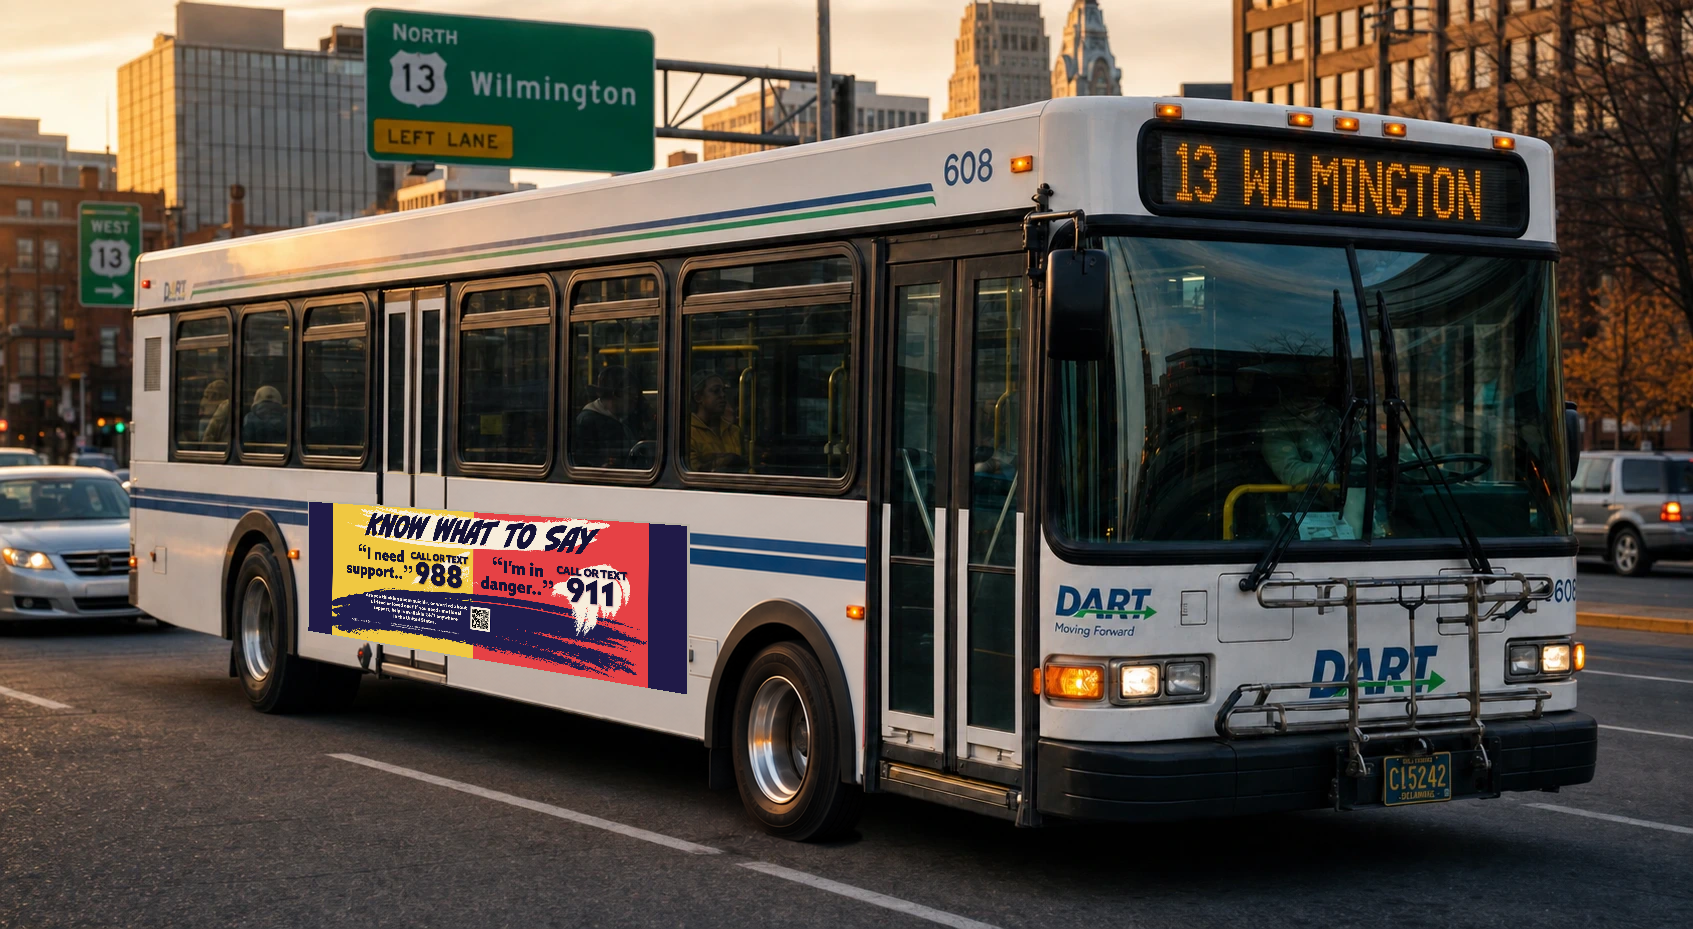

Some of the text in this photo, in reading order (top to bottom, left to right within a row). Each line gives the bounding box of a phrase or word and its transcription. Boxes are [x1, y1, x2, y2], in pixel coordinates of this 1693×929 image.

[392, 23, 458, 45] NORTH
[402, 63, 435, 94] 13
[470, 71, 636, 111] Wilmington
[388, 128, 498, 149] LEFT LANE
[944, 148, 993, 186] 608
[1176, 142, 1481, 221] 13 WILMINGTON
[91, 220, 130, 234] WEST
[99, 247, 122, 269] 13
[365, 512, 600, 554] KNOW WHAT TO SAY
[375, 550, 404, 563] need
[410, 551, 469, 565] CALL OR TEXT
[415, 561, 463, 589] 988
[529, 562, 544, 577] in
[556, 565, 628, 581] CALL OR TEXT
[566, 577, 614, 607] 911
[1055, 584, 1152, 619] DART
[1555, 578, 1576, 603] 608
[1054, 622, 1135, 638] Moving Forward
[1309, 645, 1438, 699] DART
